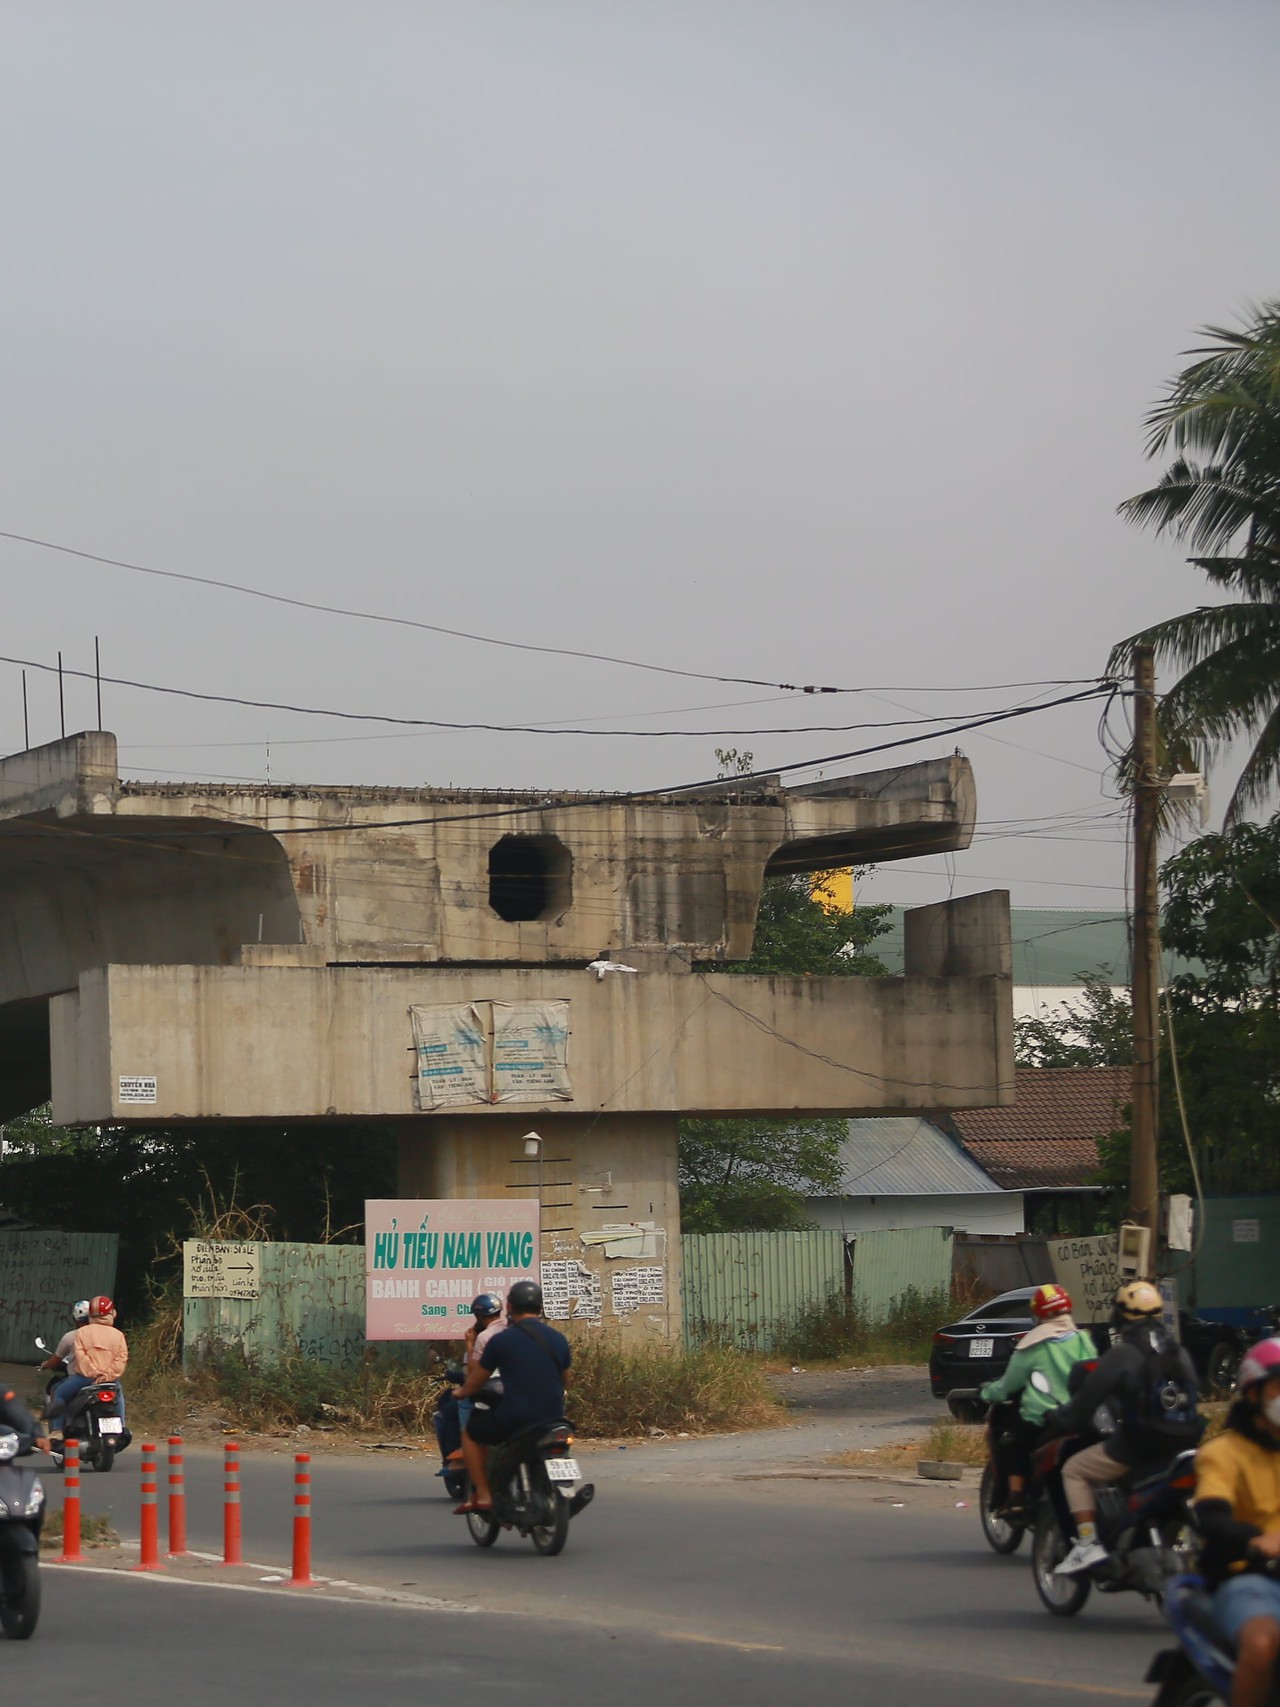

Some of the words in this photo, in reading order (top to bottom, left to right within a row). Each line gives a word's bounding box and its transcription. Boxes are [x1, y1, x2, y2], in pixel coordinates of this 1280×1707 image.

[373, 1217, 400, 1270] HỦ
[402, 1214, 439, 1270] TIẾU
[442, 1232, 482, 1269] NAM
[486, 1231, 534, 1269] VANG
[372, 1277, 420, 1298] BÁNH
[426, 1279, 473, 1298] CANH
